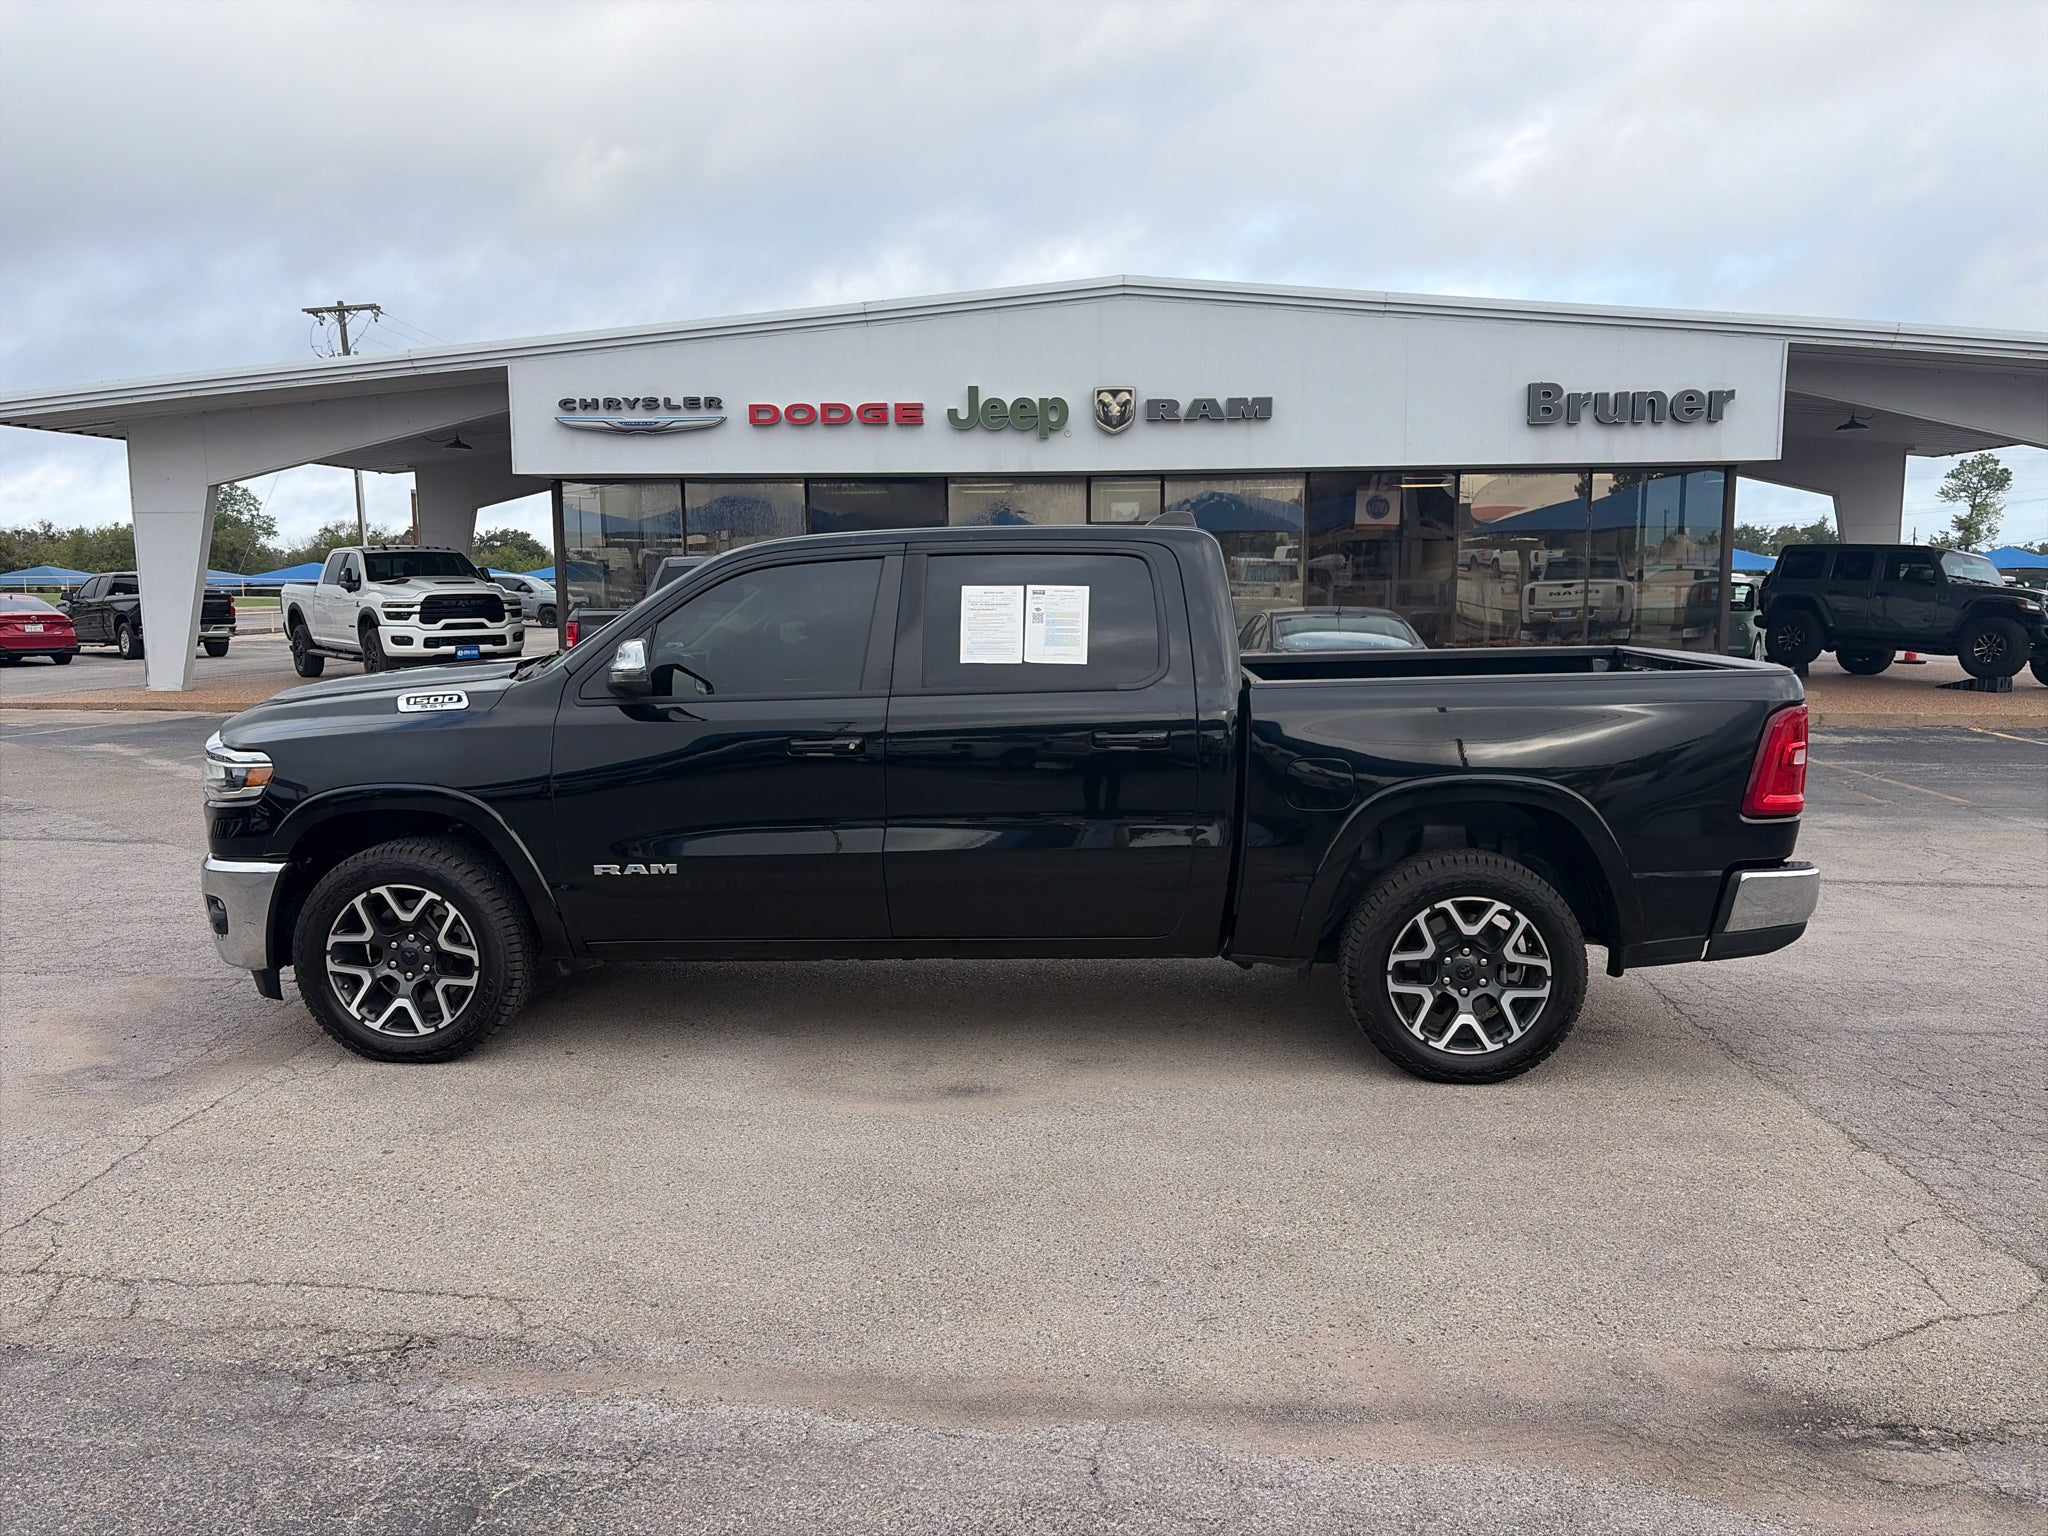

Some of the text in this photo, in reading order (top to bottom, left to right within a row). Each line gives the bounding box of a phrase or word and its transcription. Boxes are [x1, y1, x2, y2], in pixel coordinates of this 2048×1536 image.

[558, 396, 723, 411] CHRYSLER
[749, 402, 924, 425] DODGE
[947, 385, 1070, 438] Jeep
[1145, 396, 1273, 421] RAM
[1527, 381, 1736, 425] Bruner
[408, 694, 459, 705] 1500
[593, 863, 678, 876] RAM
